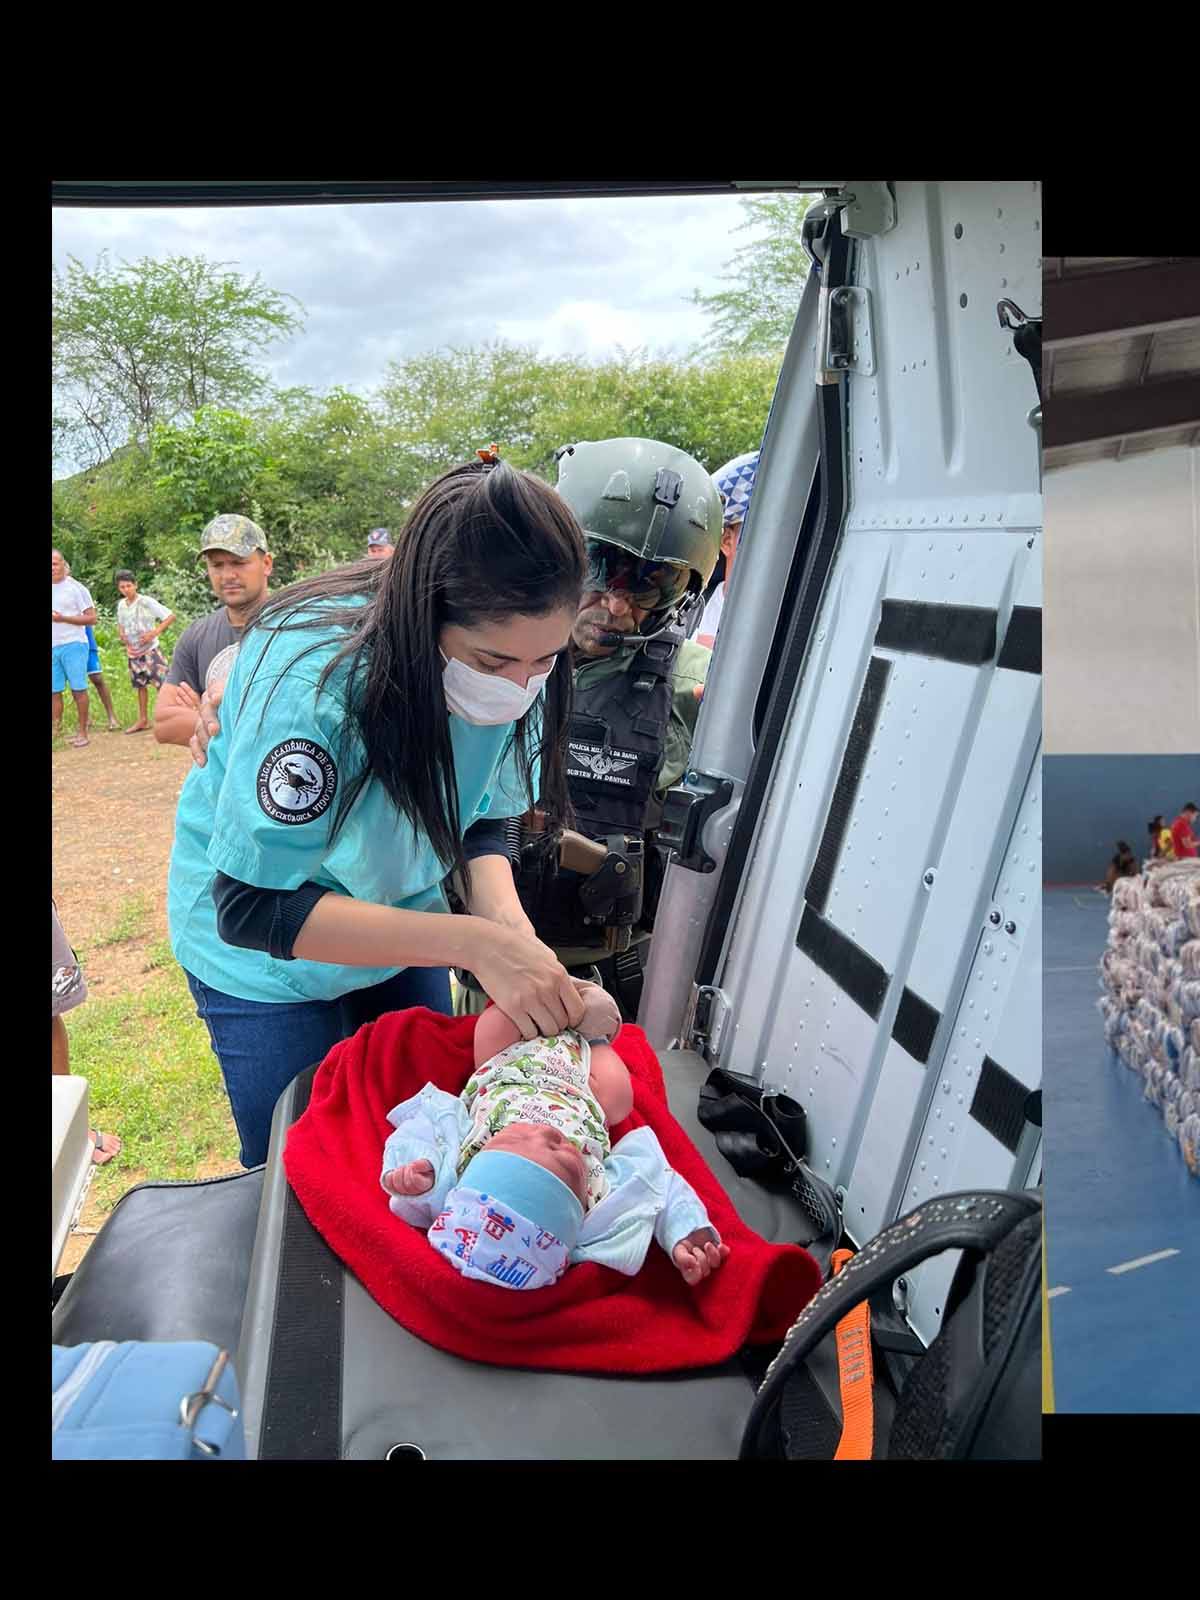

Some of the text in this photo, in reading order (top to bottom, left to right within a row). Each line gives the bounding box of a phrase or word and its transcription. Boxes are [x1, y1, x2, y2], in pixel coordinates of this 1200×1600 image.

[568, 742, 590, 752] POLÍCIA
[260, 741, 335, 813] LIGA ACADÊMICA DE ONCOLOGIA
